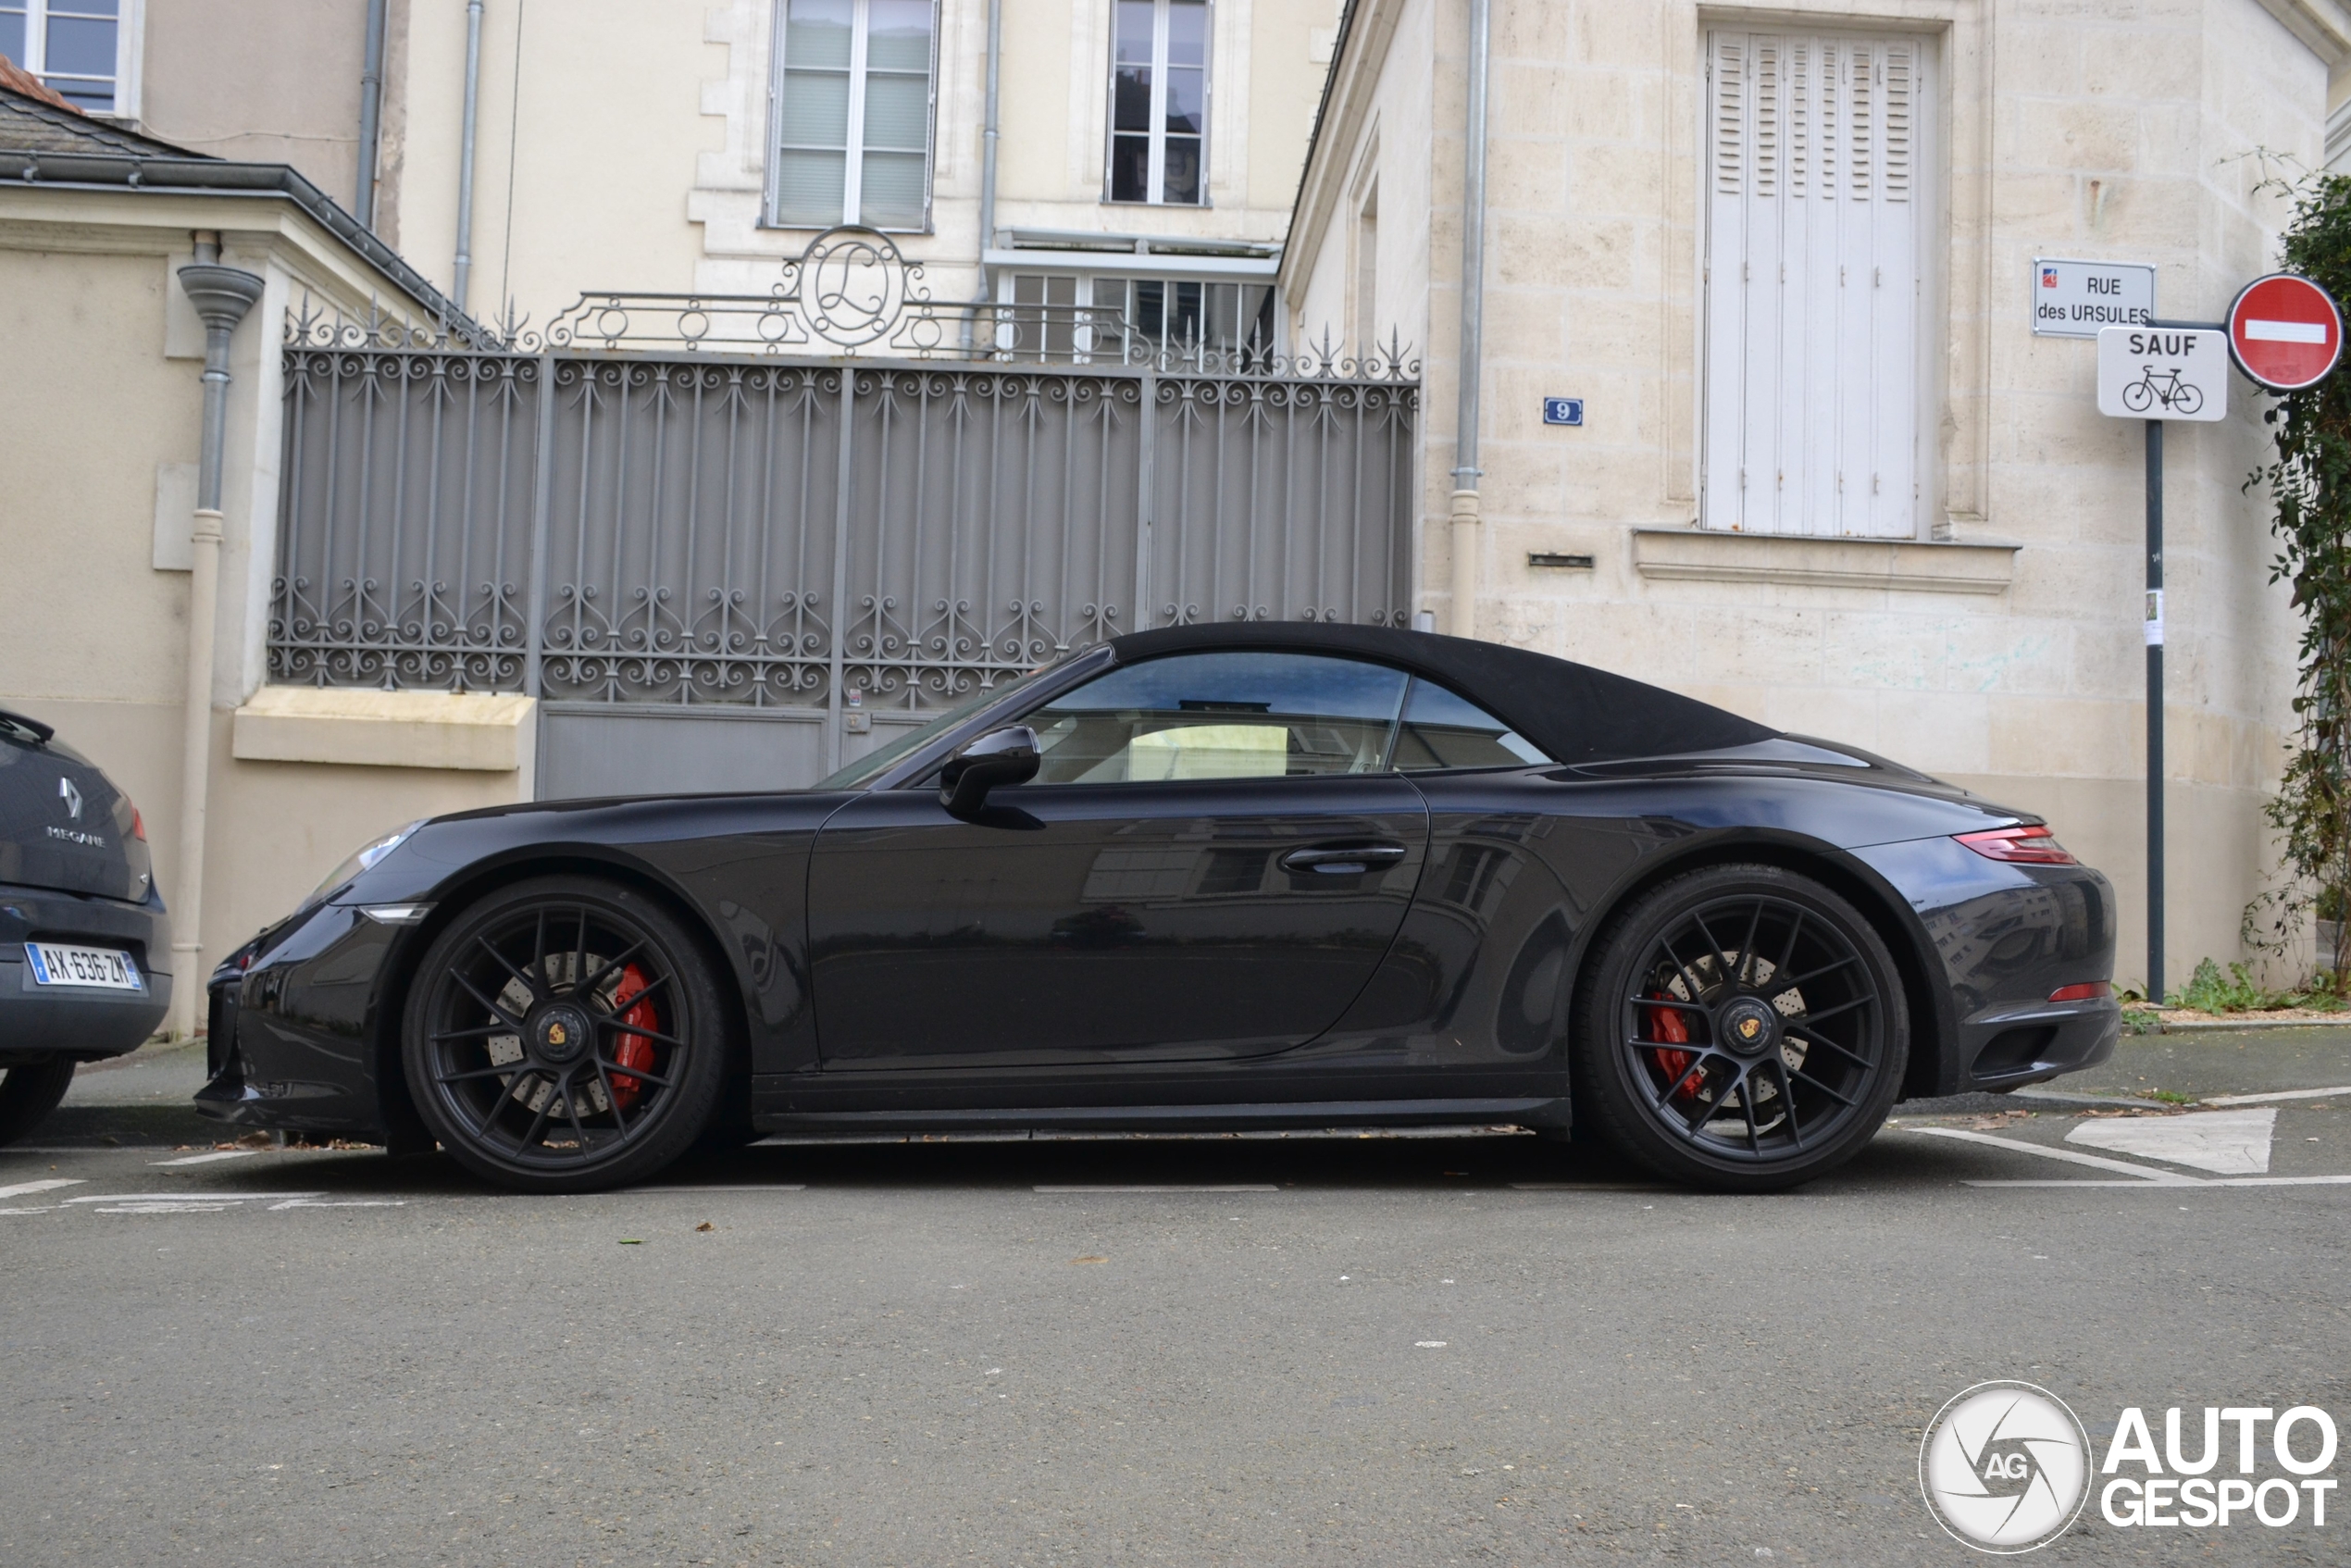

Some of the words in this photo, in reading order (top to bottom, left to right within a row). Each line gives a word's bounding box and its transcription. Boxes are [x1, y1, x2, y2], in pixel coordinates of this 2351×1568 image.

[2087, 278, 2121, 295] RUE
[2038, 303, 2066, 319] des
[2071, 305, 2149, 325] URSULES
[2129, 334, 2196, 356] SAUF
[1557, 402, 1571, 420] 9
[46, 826, 106, 849] MEGANE
[44, 950, 130, 984] AX-636-ZM
